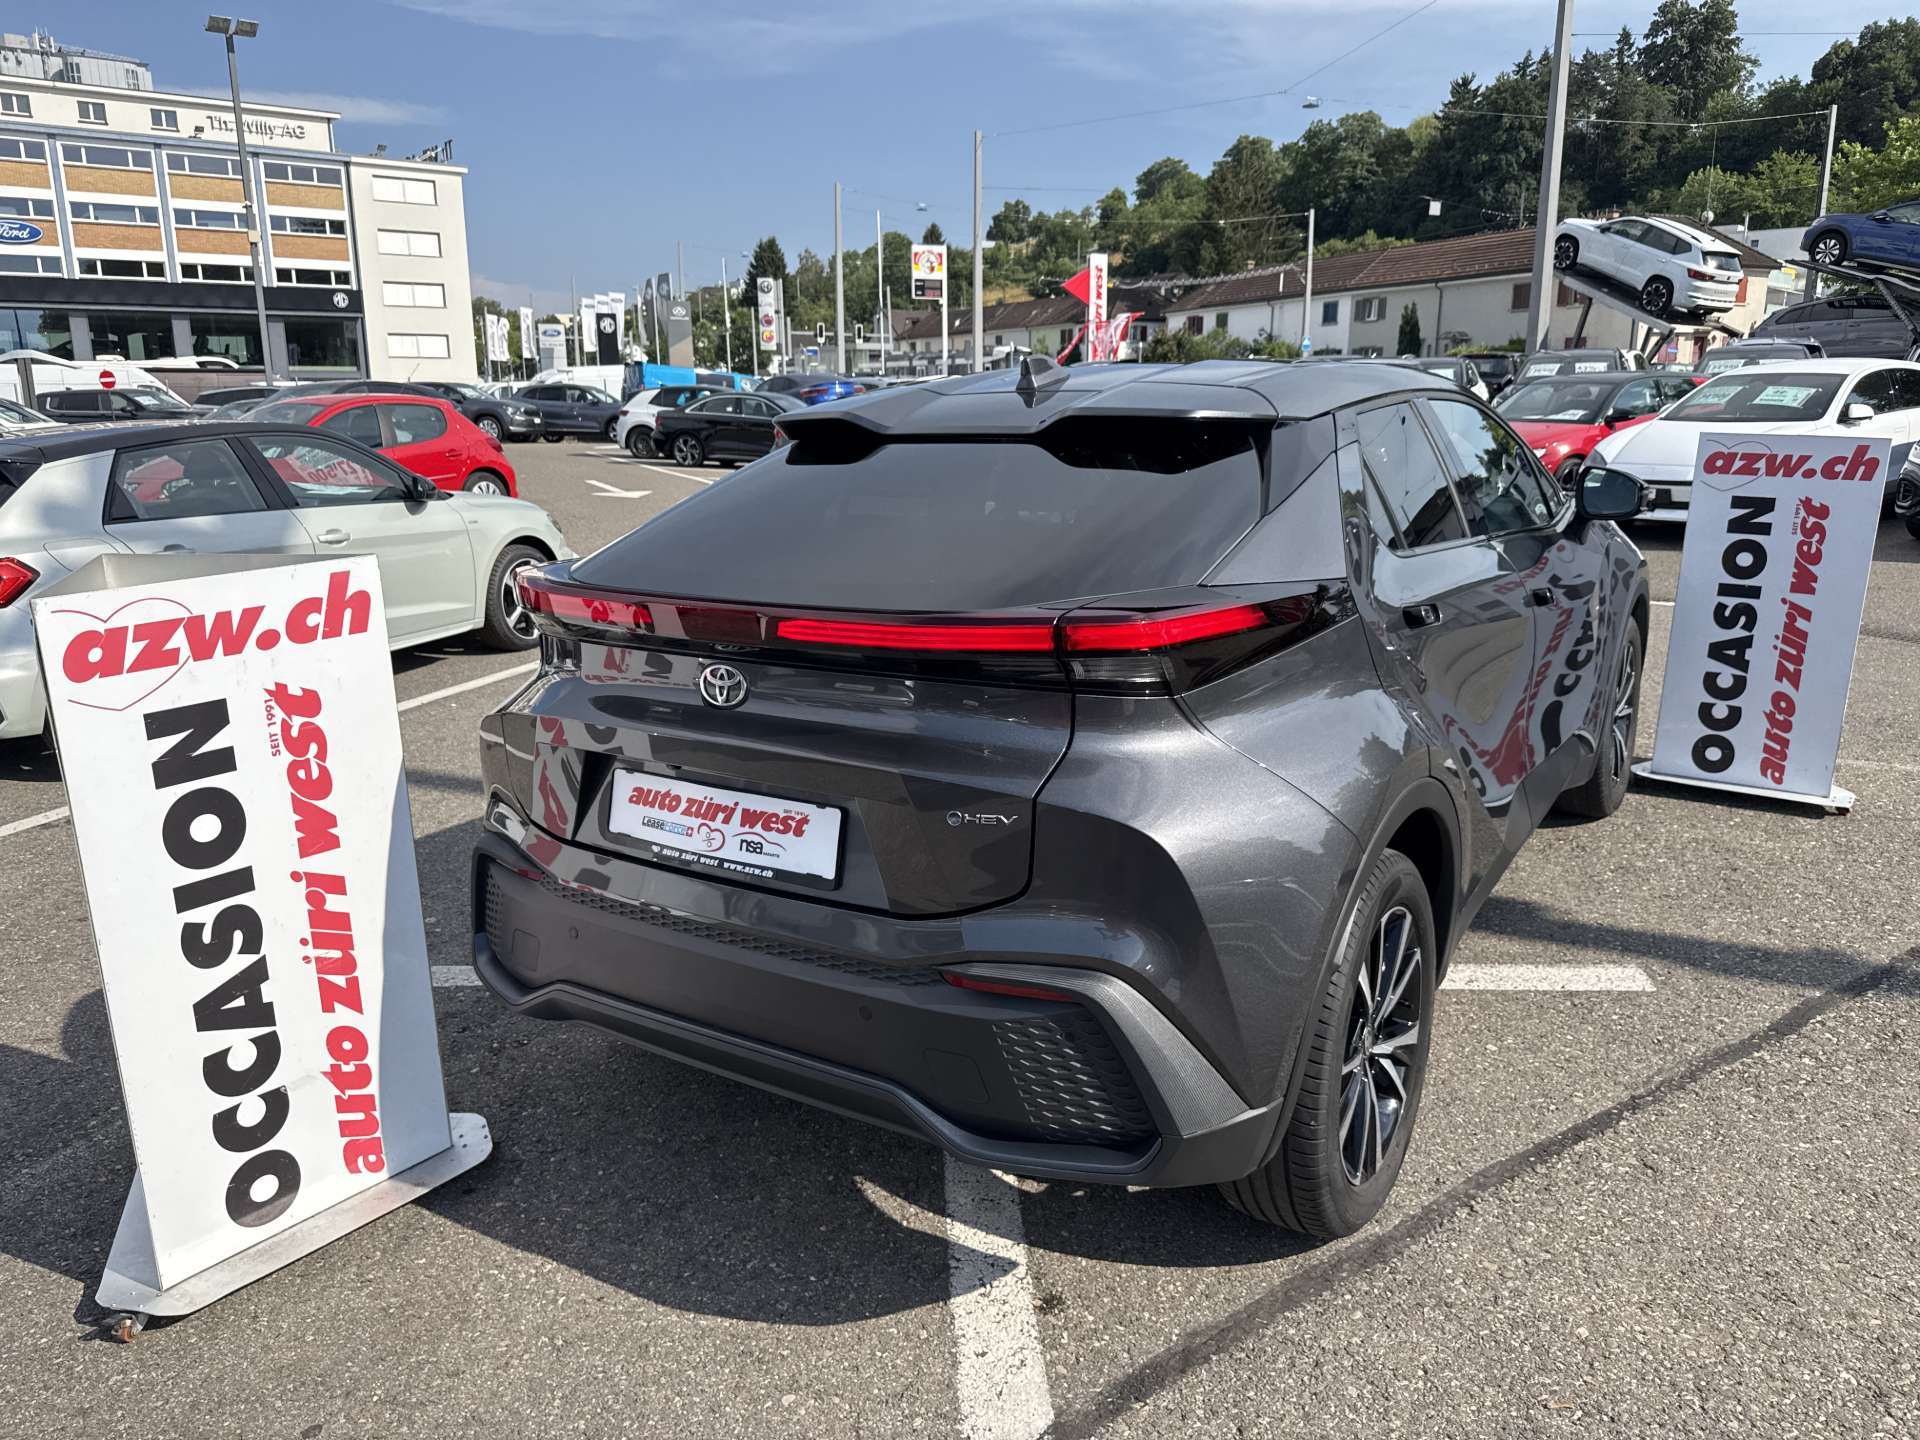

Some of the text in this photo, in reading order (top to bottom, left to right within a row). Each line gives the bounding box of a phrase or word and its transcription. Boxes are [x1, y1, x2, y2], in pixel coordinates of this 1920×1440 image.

[281, 123, 306, 139] AG
[0, 223, 30, 238] Ford
[1703, 444, 1880, 481] azw.ch
[62, 571, 371, 683] azw.ch
[1691, 495, 1776, 774] OCCASION
[1760, 496, 1830, 785] auto züri west
[263, 697, 281, 757] SEIT 1991
[628, 786, 810, 838] auto züri west
[963, 813, 1019, 826] HEV
[662, 848, 680, 858] auto
[700, 856, 719, 867] west
[723, 861, 774, 878] www.azw.ch
[739, 838, 763, 855] nsa
[263, 682, 387, 1175] auto züri west
[143, 698, 301, 1228] OCCASION
